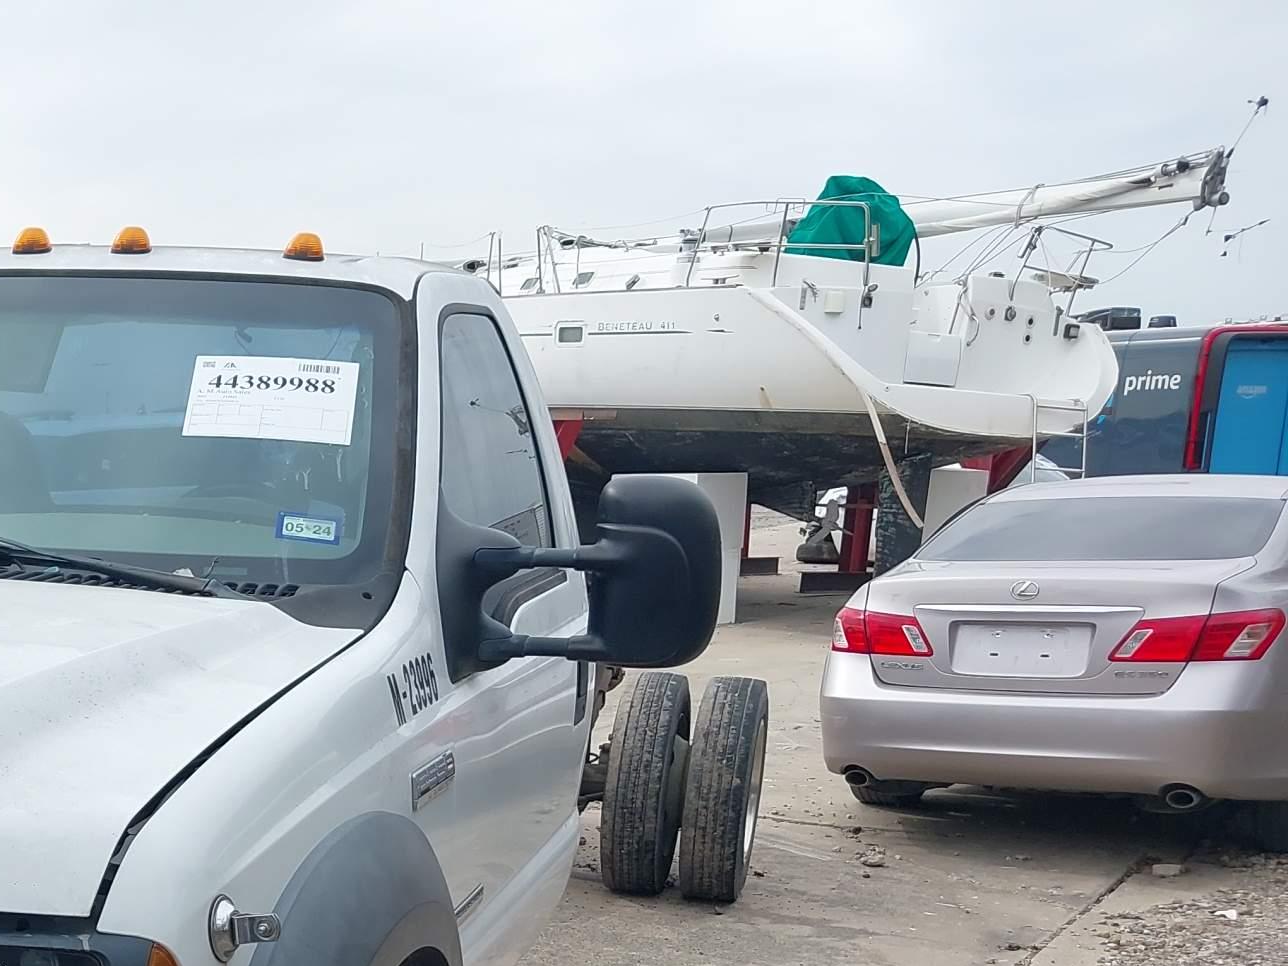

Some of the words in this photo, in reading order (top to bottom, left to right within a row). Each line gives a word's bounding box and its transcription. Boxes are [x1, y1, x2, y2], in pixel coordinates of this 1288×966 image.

[597, 322, 653, 332] BENETEAU
[208, 374, 336, 394] 44389988
[1123, 369, 1182, 396] prime
